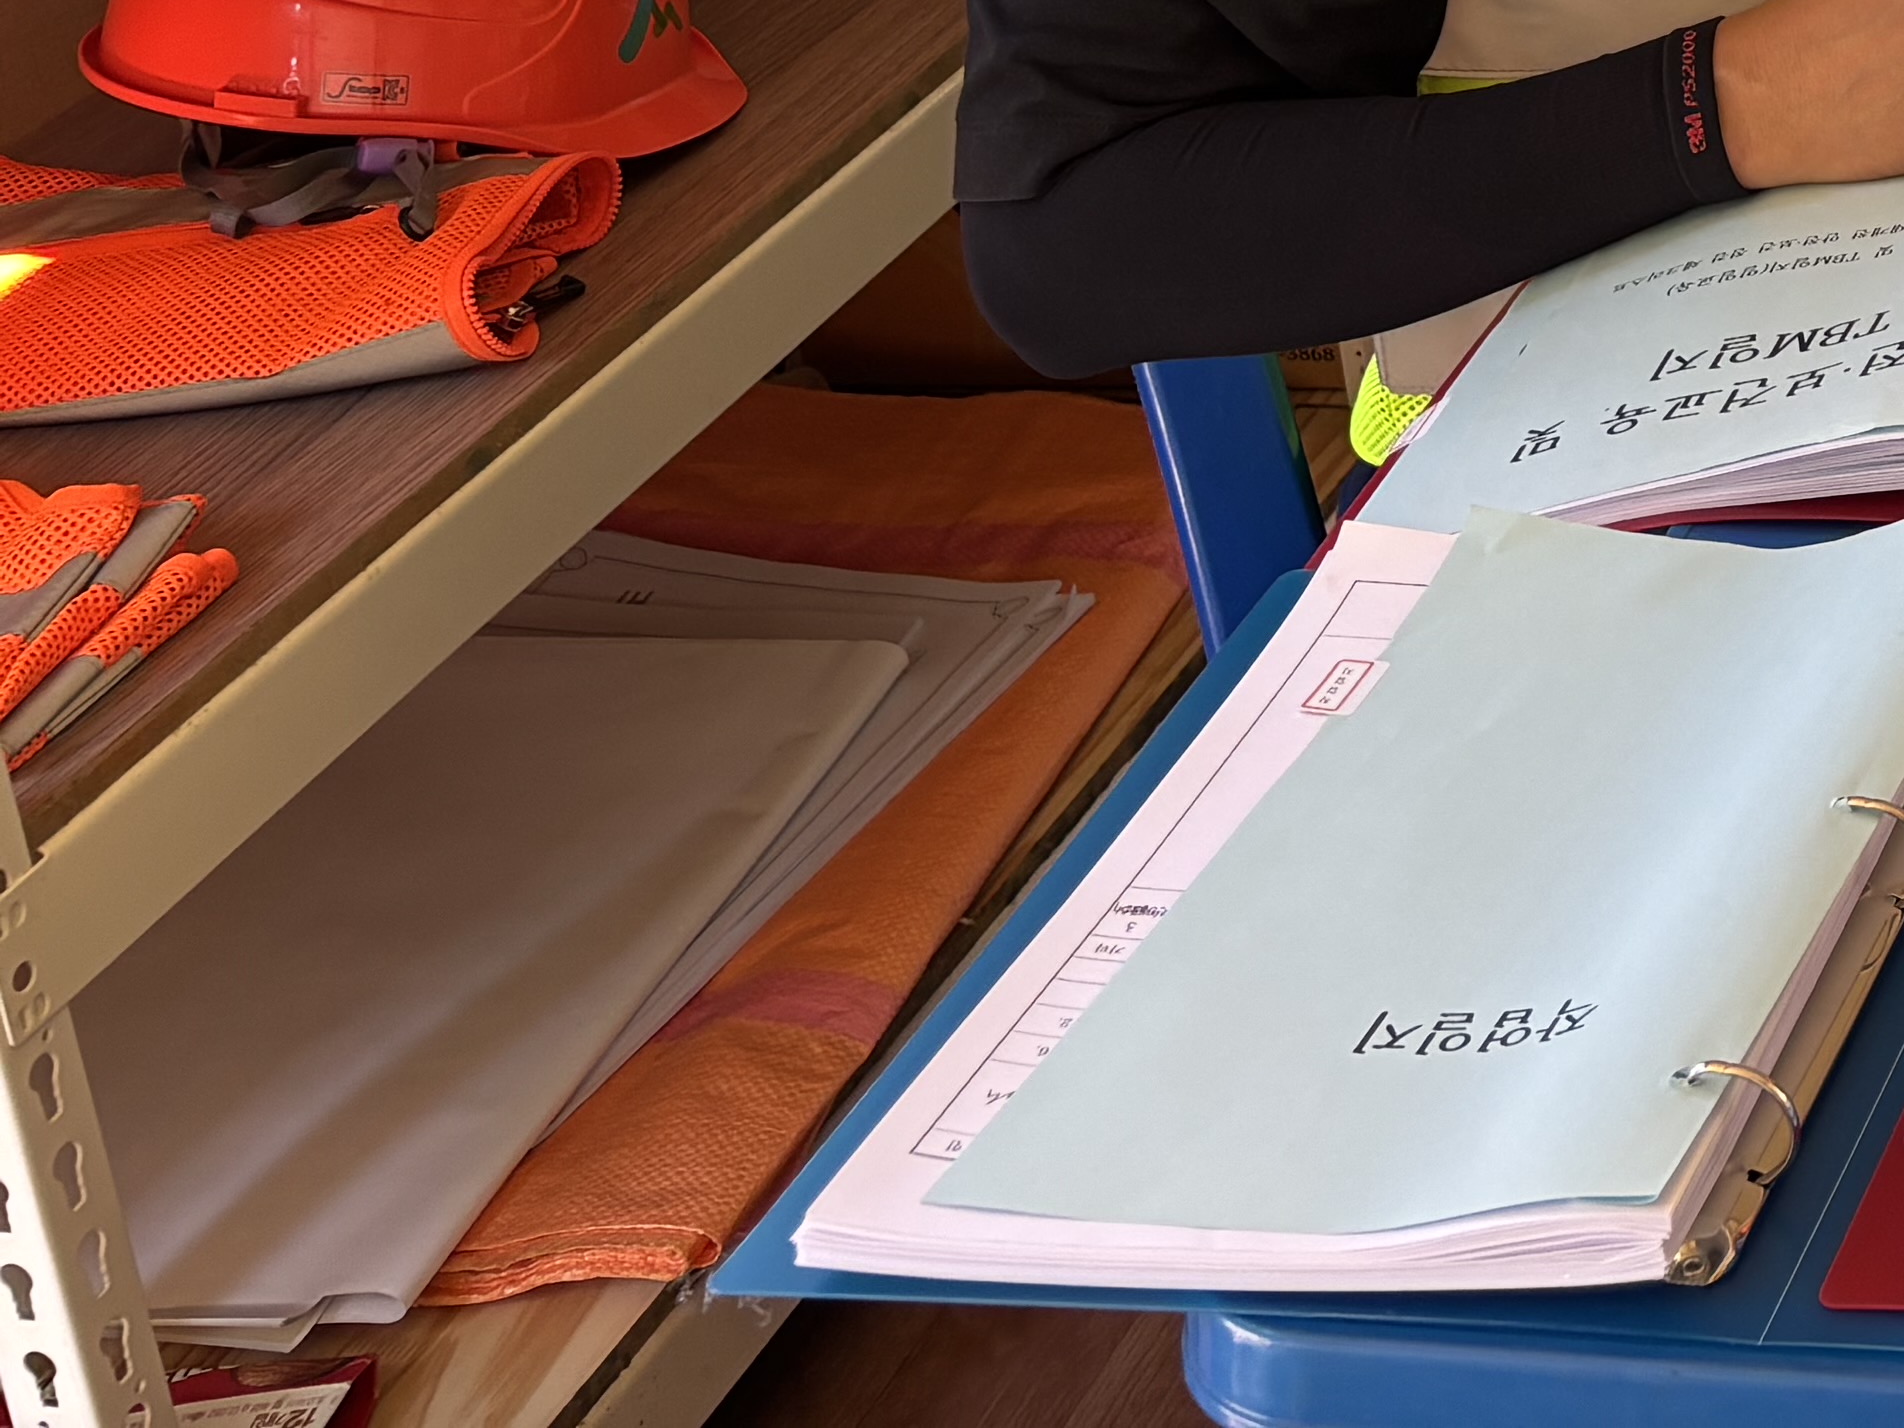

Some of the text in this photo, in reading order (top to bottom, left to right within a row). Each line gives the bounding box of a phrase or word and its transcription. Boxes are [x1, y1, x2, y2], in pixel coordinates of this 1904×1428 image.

[1649, 309, 1891, 382] TBM일지
[1509, 419, 1565, 463] 및
[1353, 995, 1600, 1059] 작업일지
